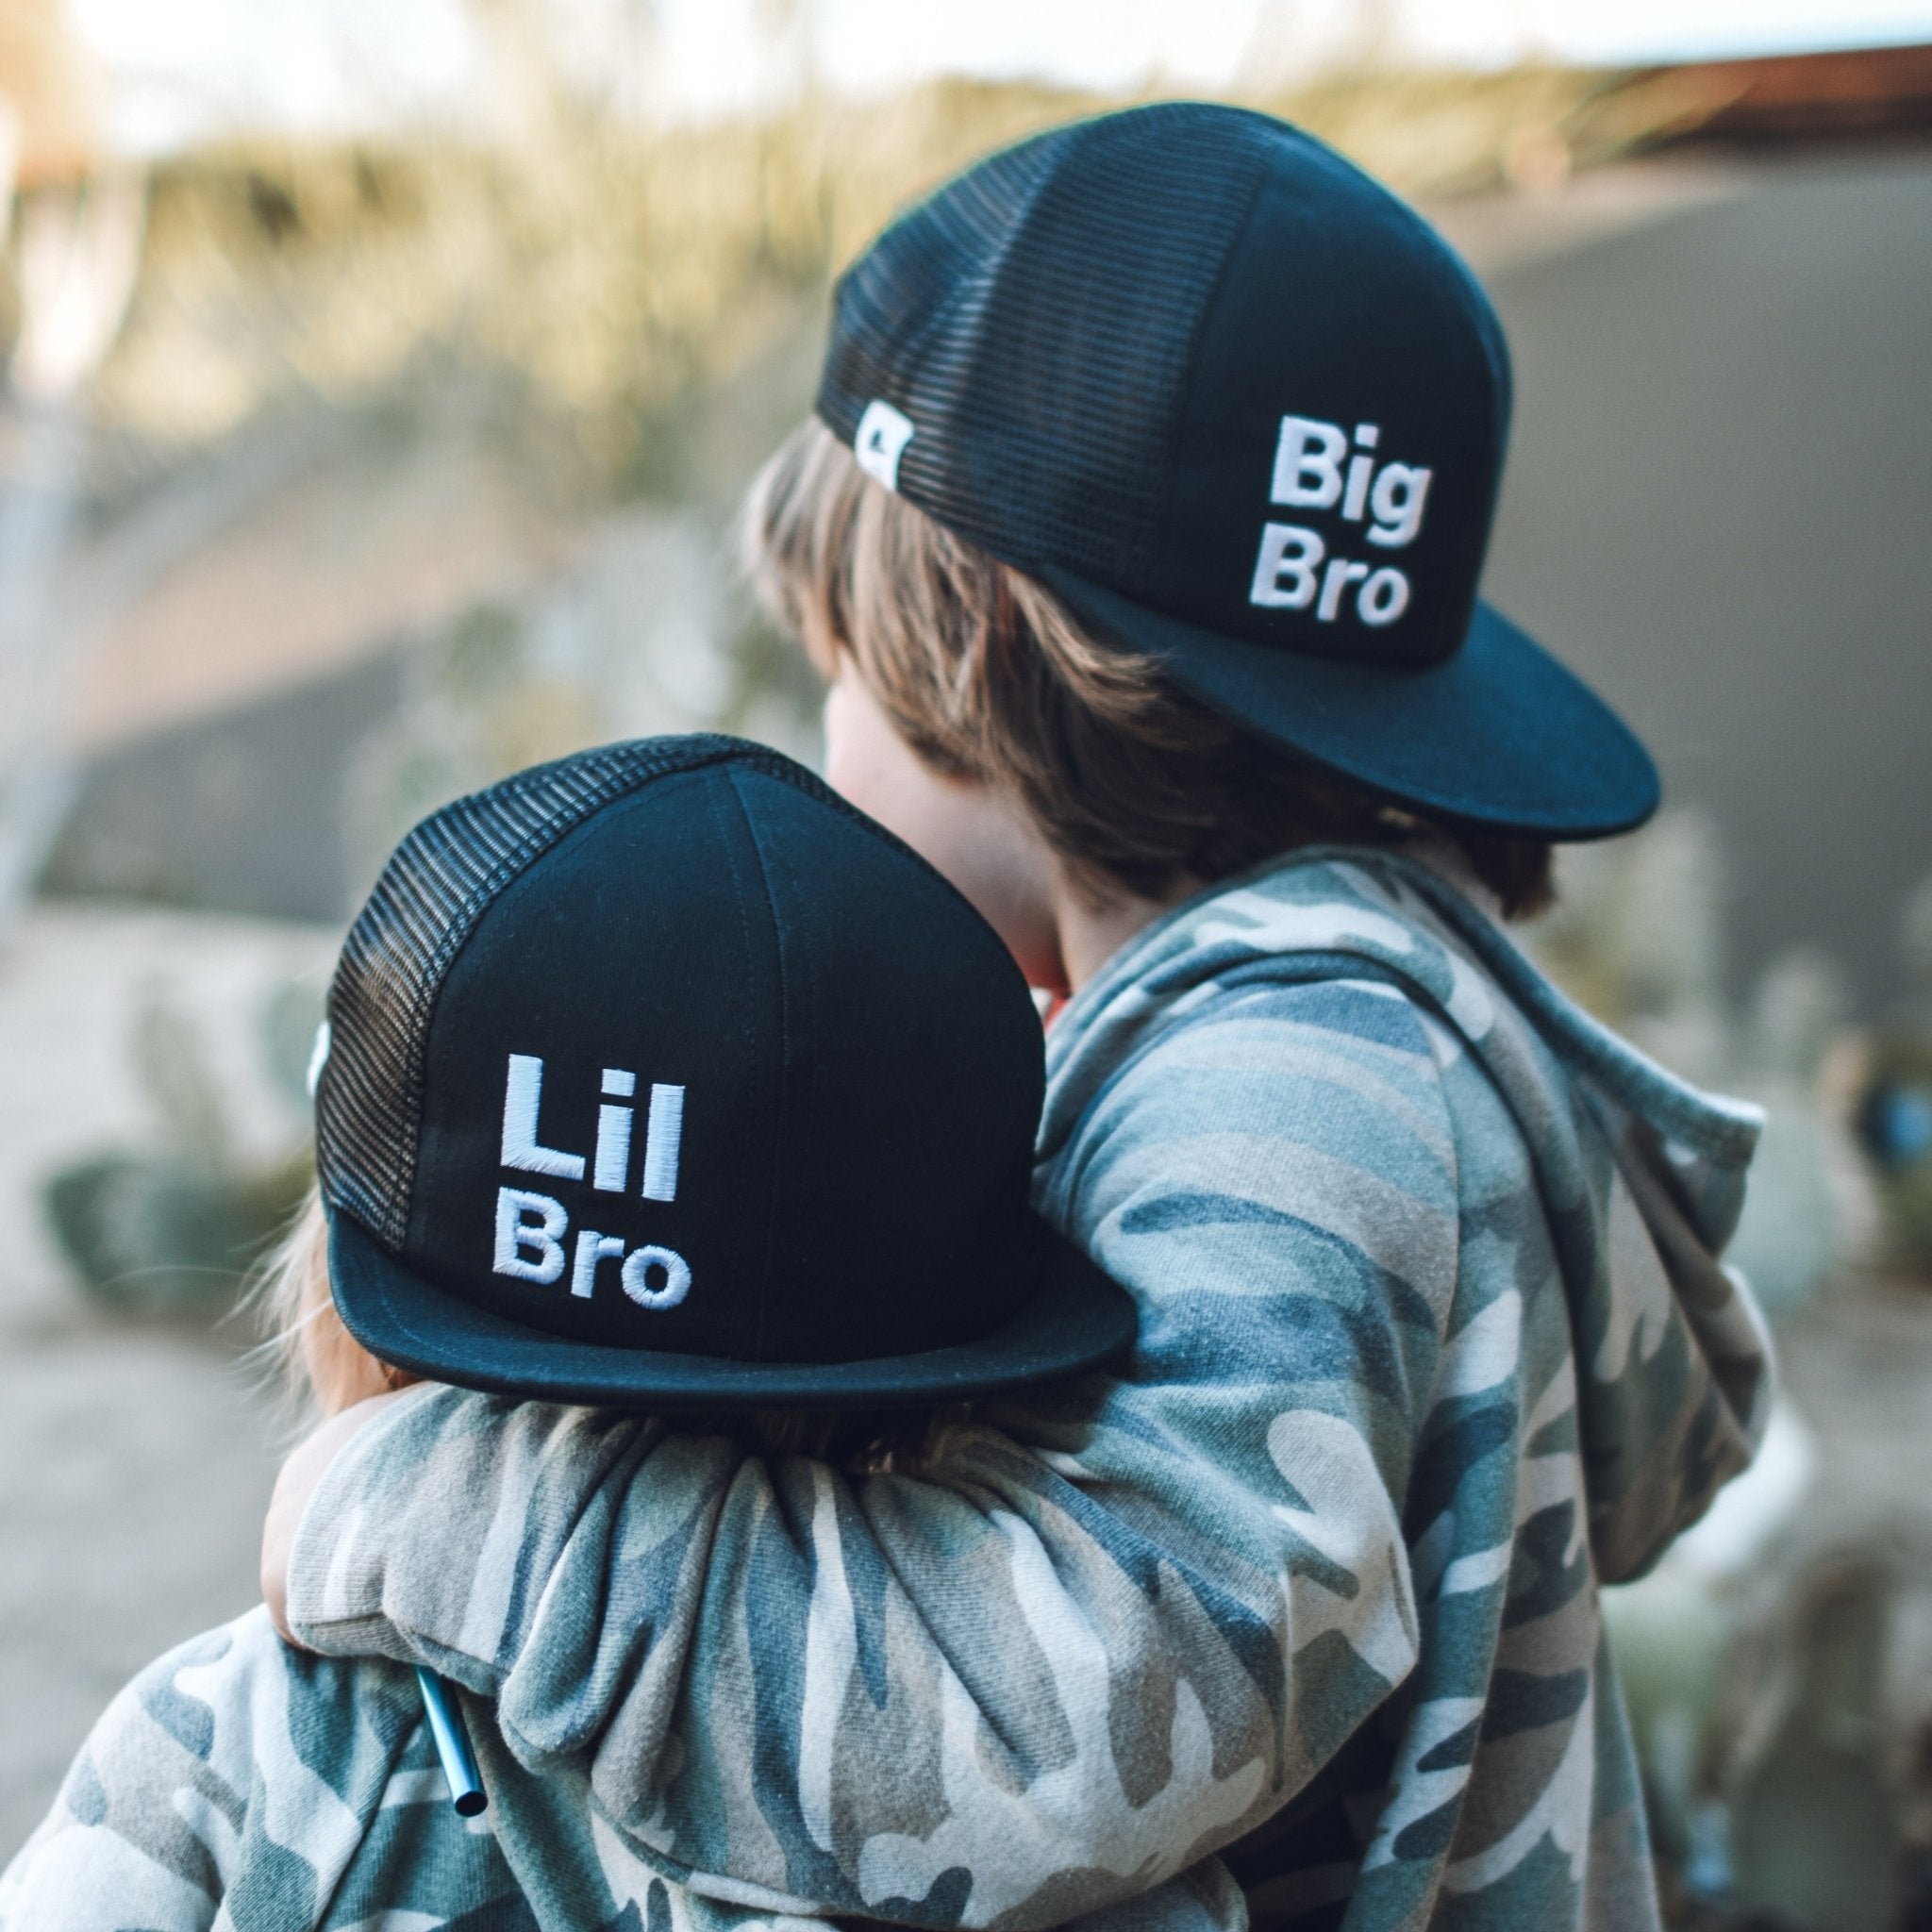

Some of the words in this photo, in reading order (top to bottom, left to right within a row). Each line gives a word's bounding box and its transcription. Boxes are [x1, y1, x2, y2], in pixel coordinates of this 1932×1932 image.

[1270, 414, 1433, 547] Big
[1249, 522, 1410, 626] Bro
[499, 1053, 686, 1203] Lil
[491, 1186, 692, 1310] Bro
